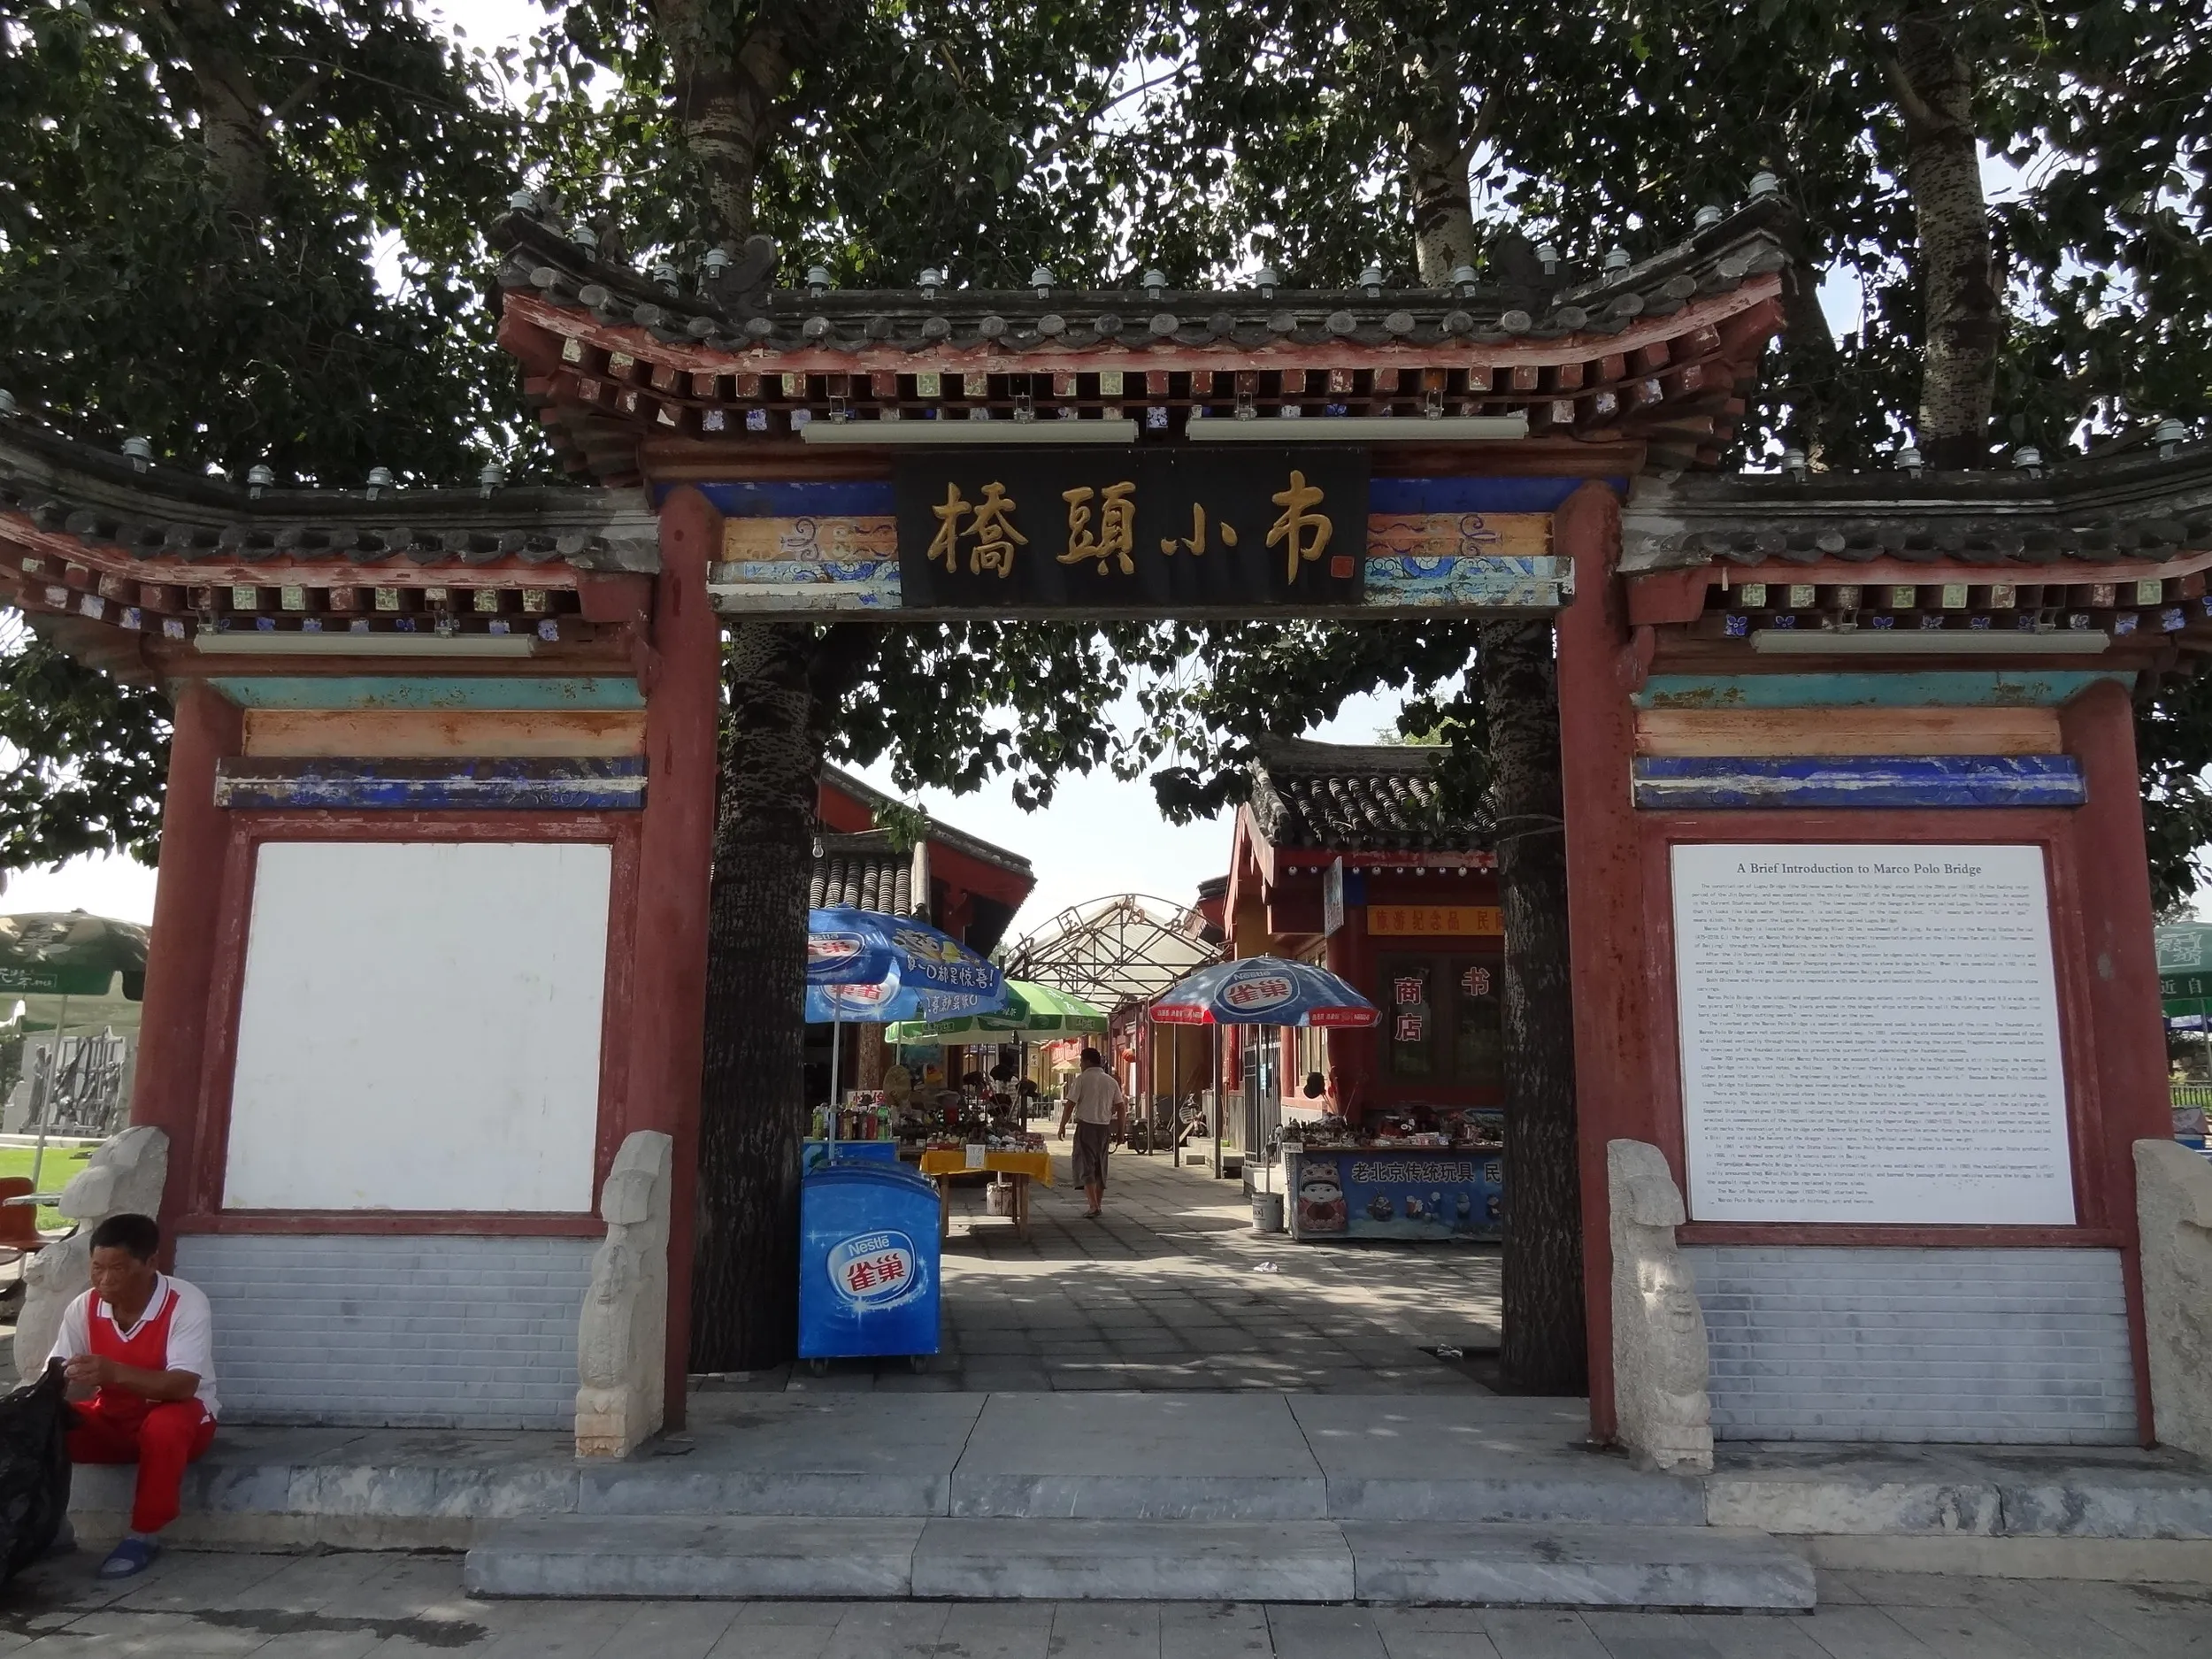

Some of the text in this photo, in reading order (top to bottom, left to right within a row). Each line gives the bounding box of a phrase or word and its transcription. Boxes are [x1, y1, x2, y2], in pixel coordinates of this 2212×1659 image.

[926, 469, 1333, 586] 橋頭小市
[1737, 864, 1746, 872] A
[1750, 863, 1779, 873] Brief
[1781, 864, 1854, 873] Introduction
[1874, 864, 1909, 873] Marco
[1914, 864, 1939, 873] Polo
[1944, 864, 1981, 877] Bridge
[1226, 979, 1290, 1005] 雀巢
[1462, 967, 1490, 996] 书
[1394, 977, 1423, 1041] 商店
[1352, 1161, 1502, 1183] 老北京传统玩具 民
[848, 1235, 890, 1257] Nestlé
[847, 1253, 906, 1293] 雀巢
